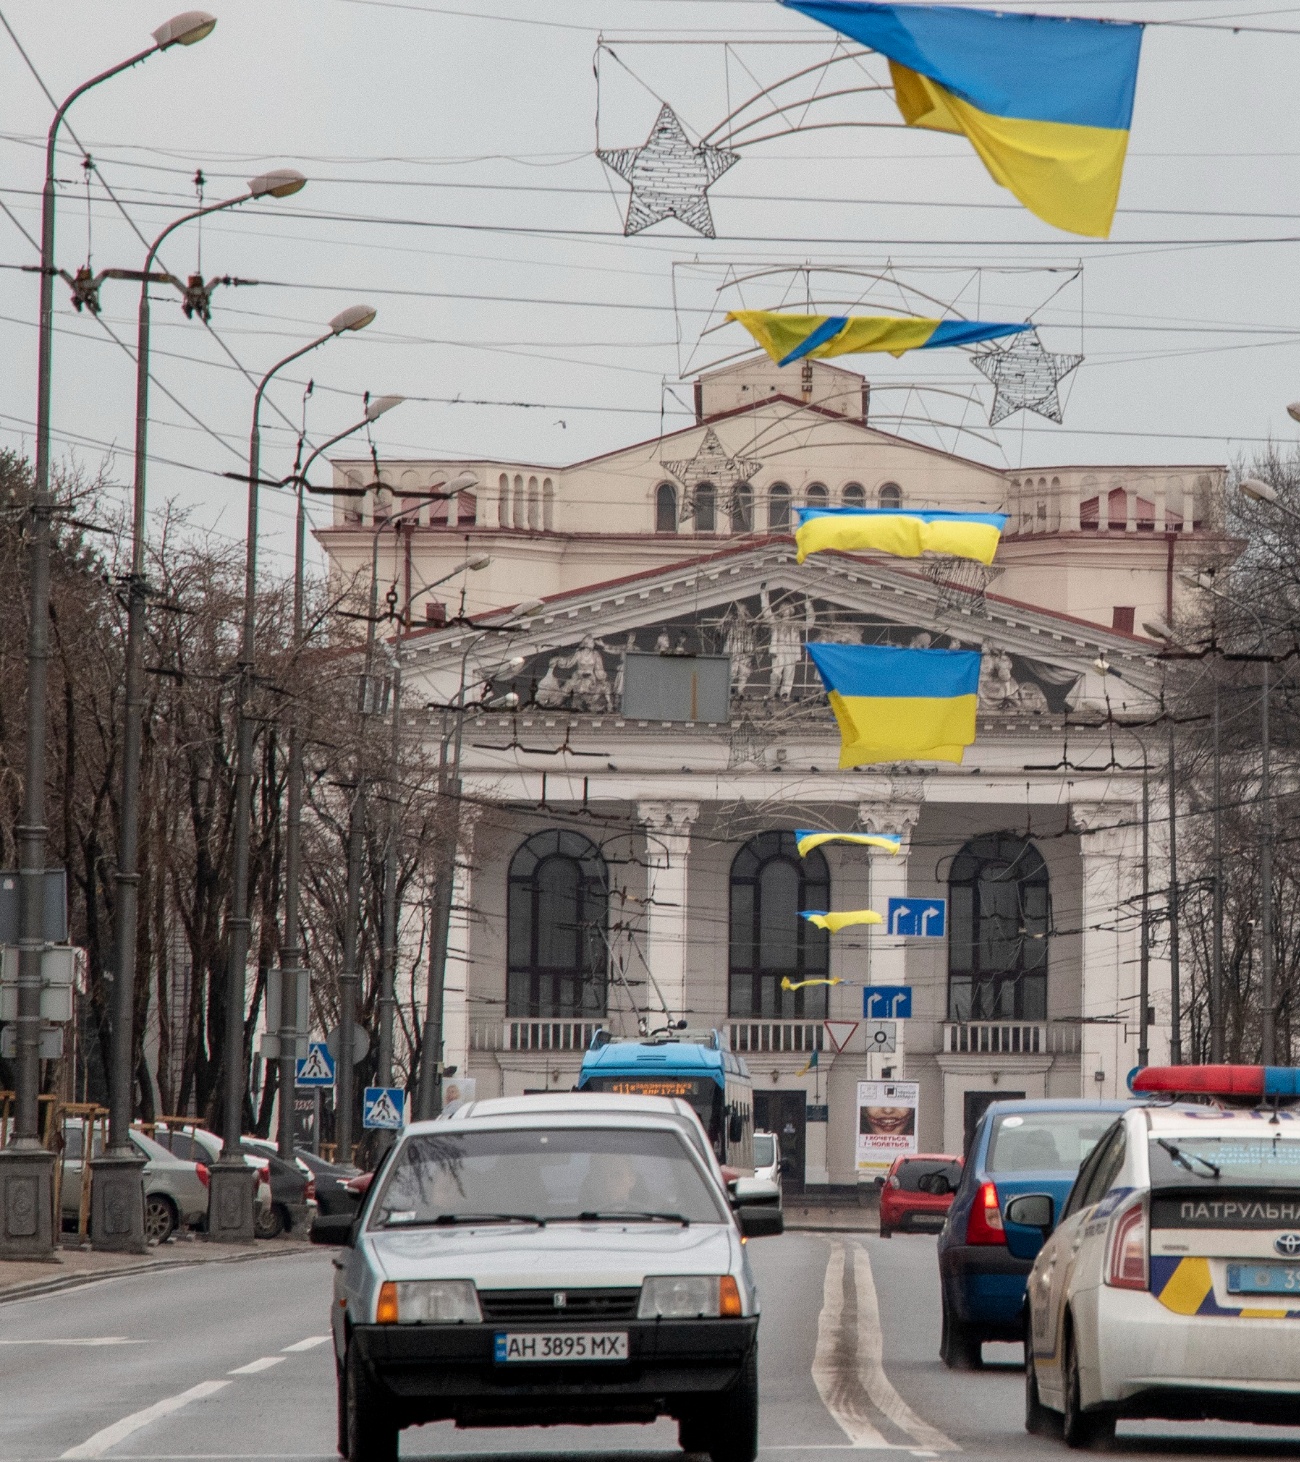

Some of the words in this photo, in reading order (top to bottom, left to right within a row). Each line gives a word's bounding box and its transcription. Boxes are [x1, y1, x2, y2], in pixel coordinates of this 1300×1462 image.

[508, 1337, 537, 1357] AH
[541, 1337, 586, 1356] 3895
[591, 1336, 620, 1356] MX
